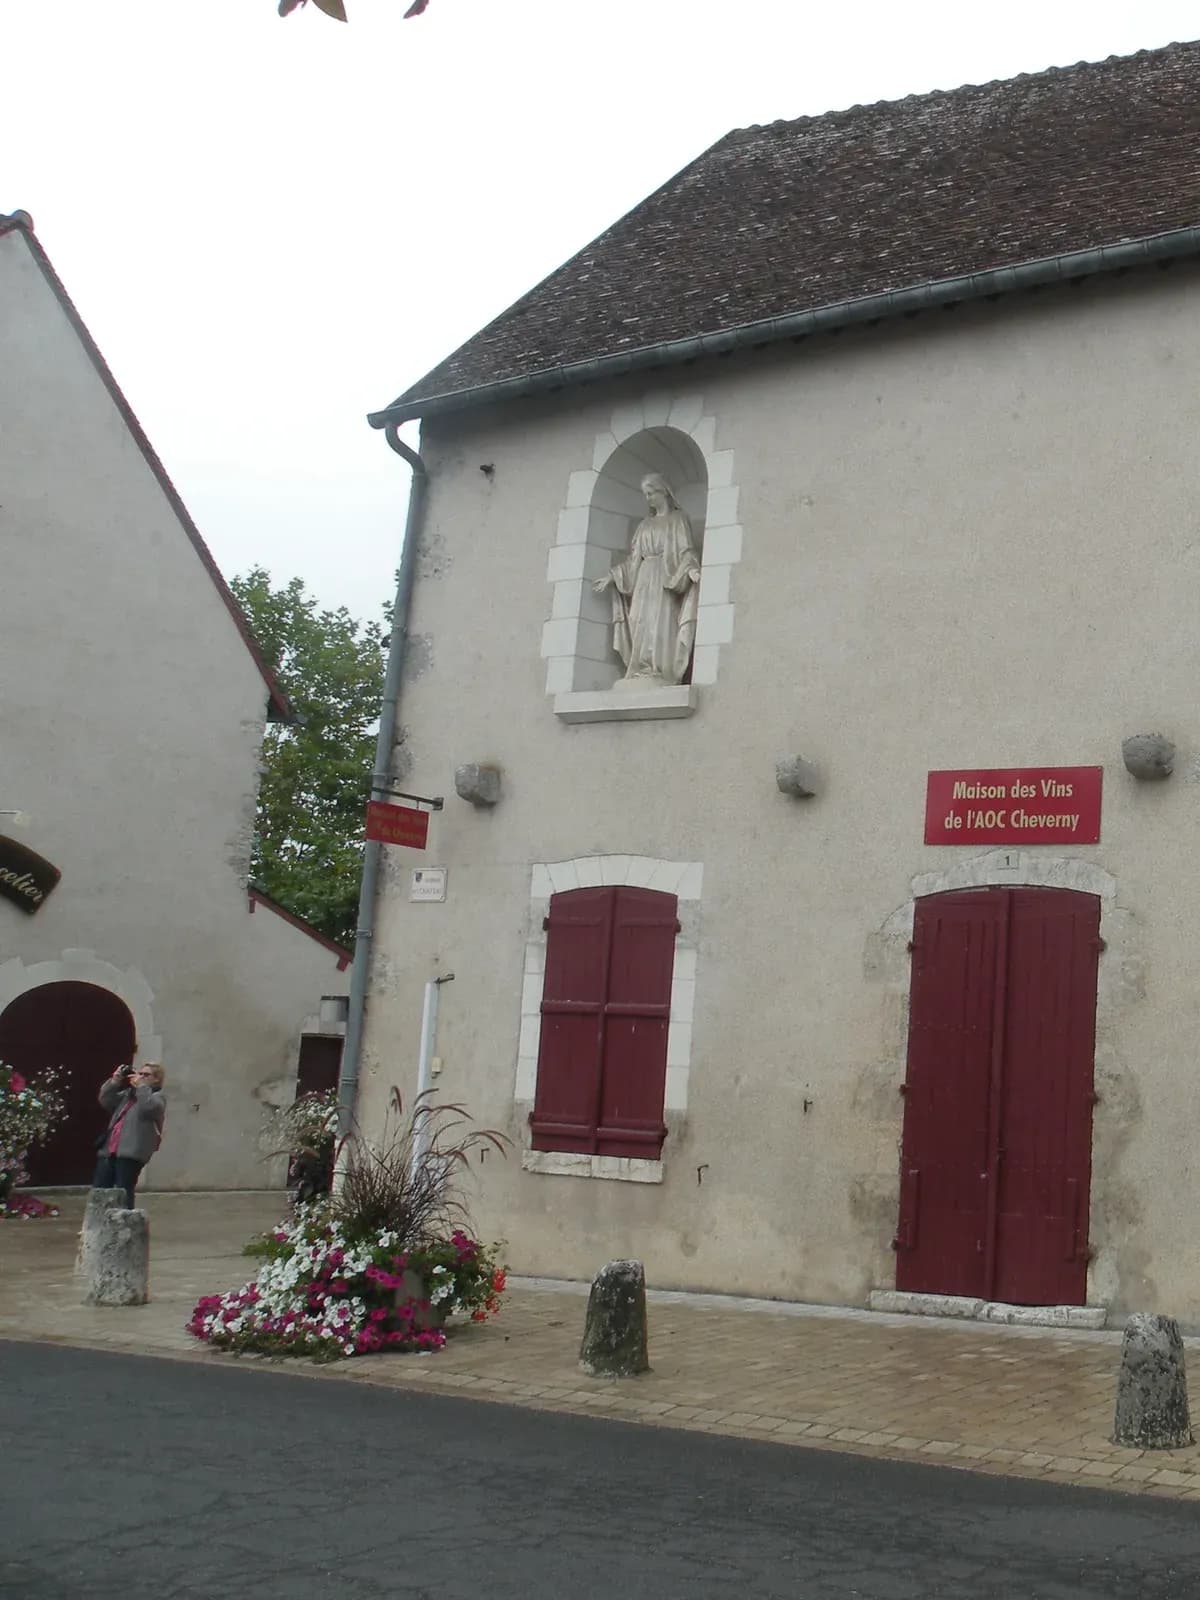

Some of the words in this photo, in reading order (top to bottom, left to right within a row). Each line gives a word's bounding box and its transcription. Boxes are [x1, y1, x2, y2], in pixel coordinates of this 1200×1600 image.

[953, 781, 1006, 799] Maison
[1010, 779, 1036, 798] des
[1041, 779, 1073, 797] Vins
[944, 810, 962, 829] de
[967, 809, 1006, 829] l'AOC
[1010, 809, 1080, 831] Cheverny
[1005, 855, 1010, 866] 1
